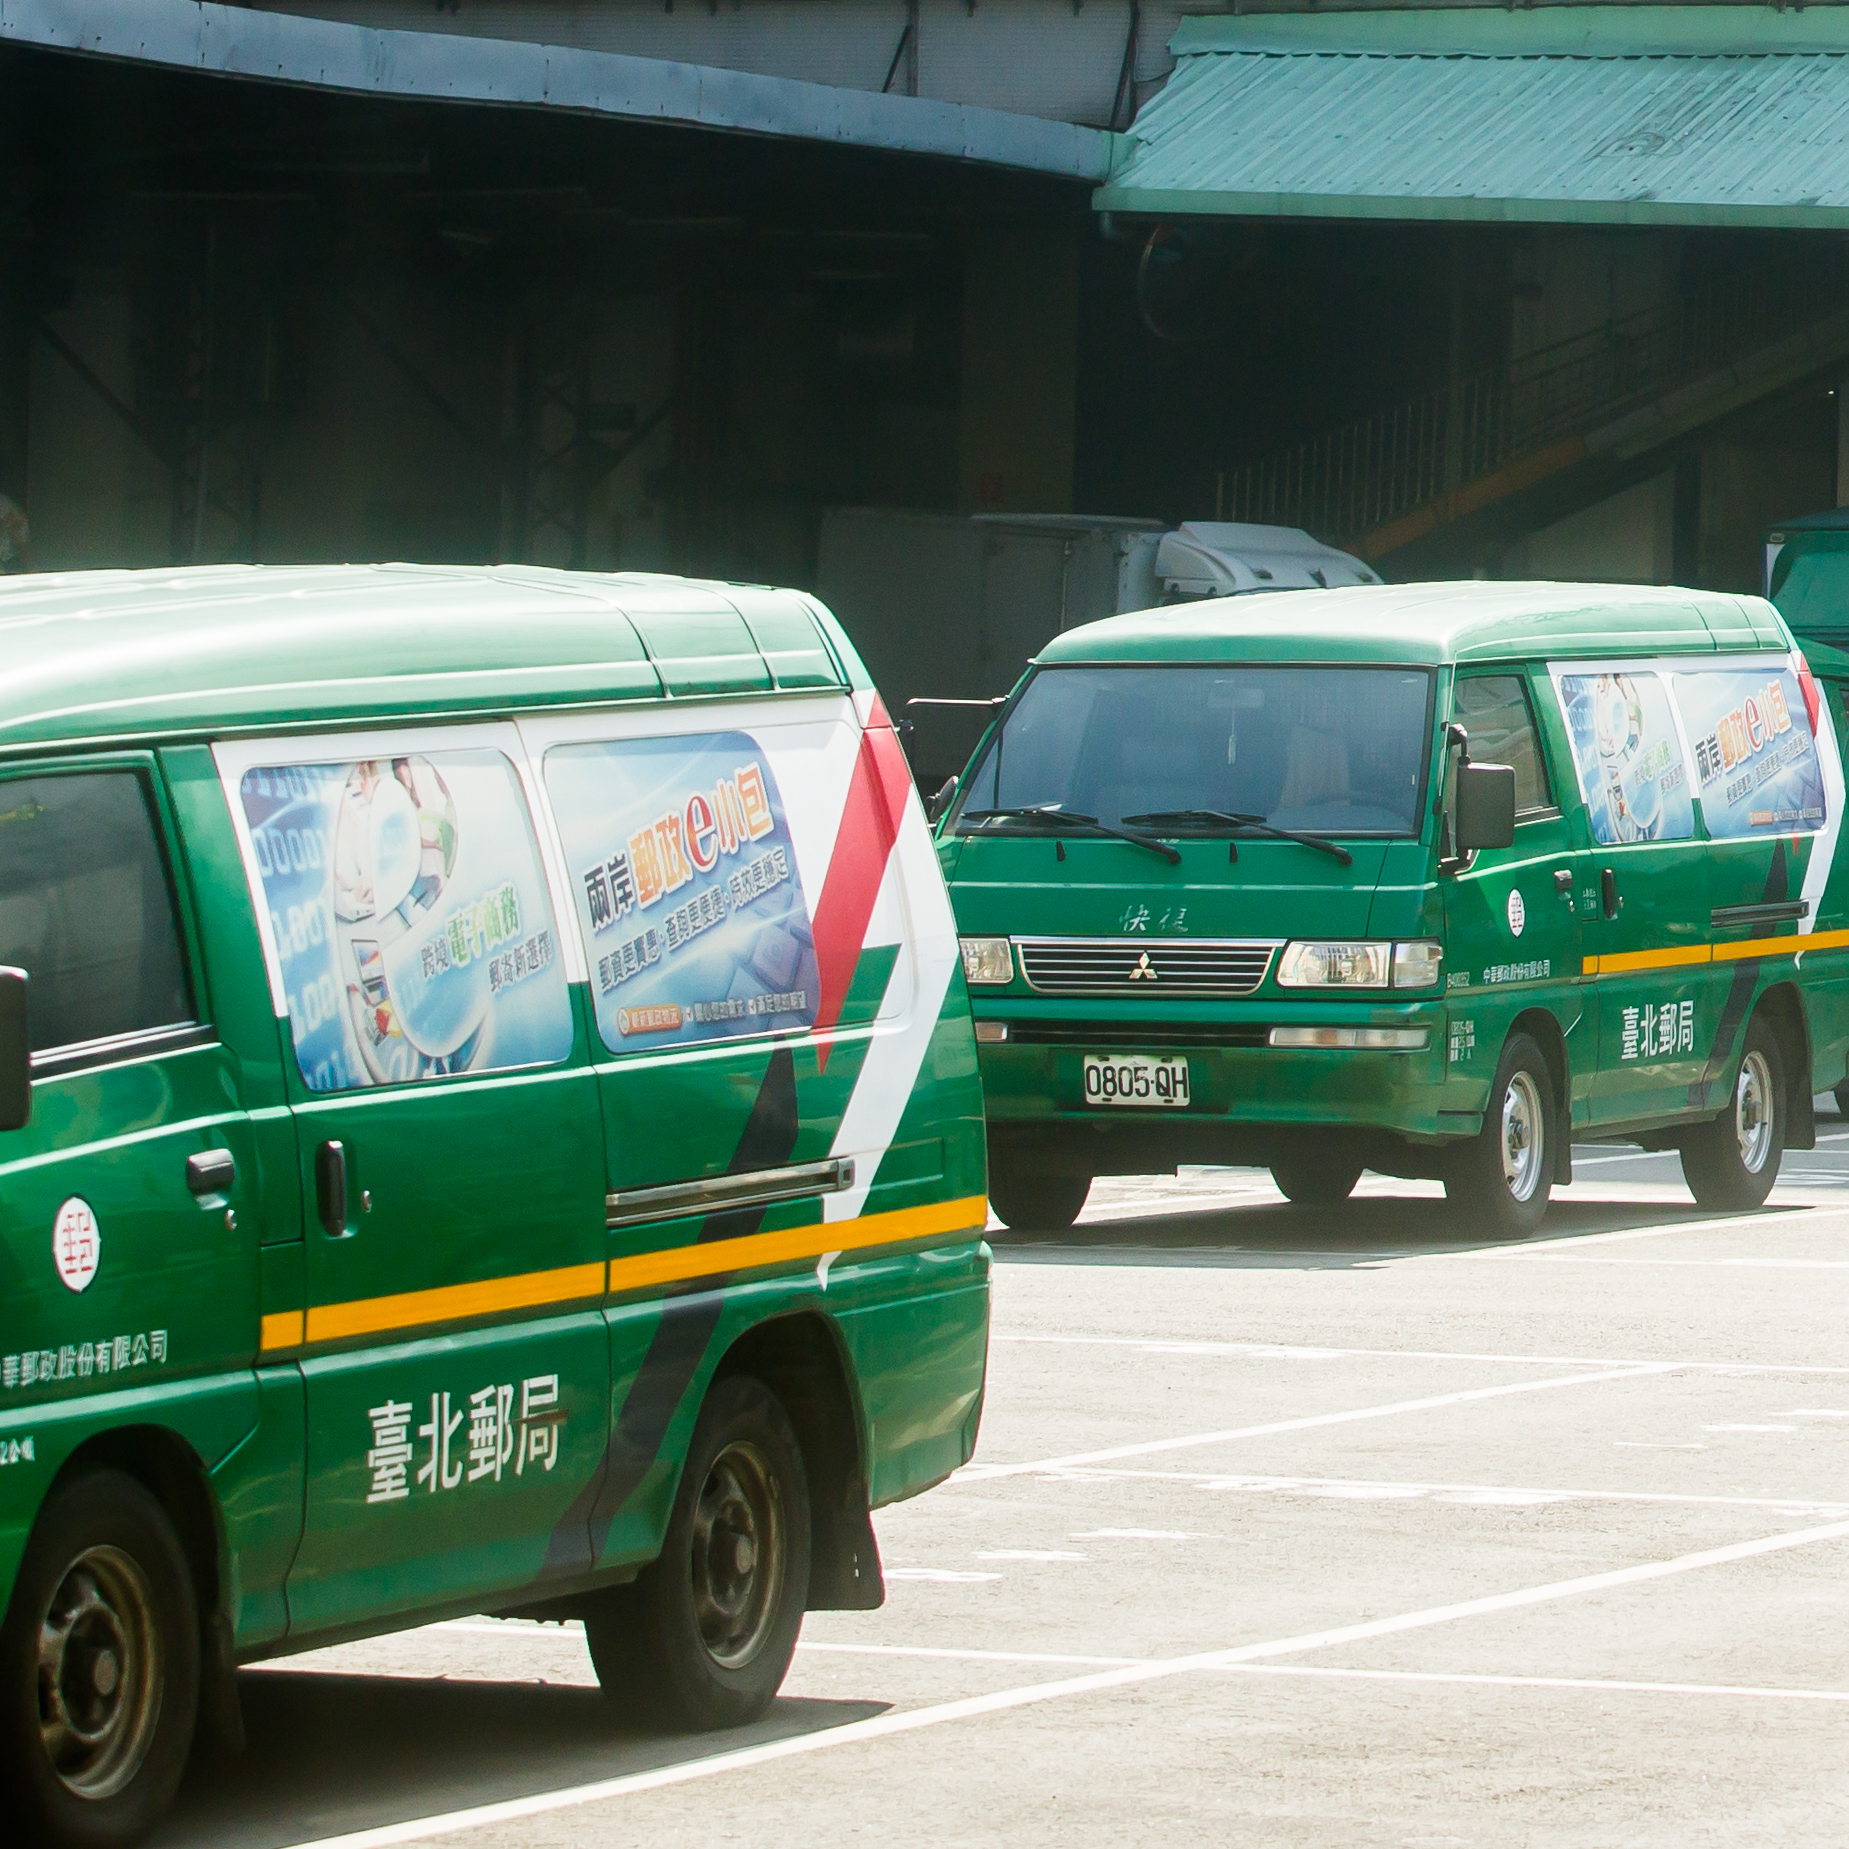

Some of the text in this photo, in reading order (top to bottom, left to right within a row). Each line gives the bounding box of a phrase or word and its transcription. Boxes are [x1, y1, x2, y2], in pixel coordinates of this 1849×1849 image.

[583, 765, 773, 929] 兩岸郵政e小包
[1483, 959, 1550, 985] 中華郵政股份有限公司
[1620, 999, 1694, 1060] 臺北郵局
[0, 1329, 168, 1388] 華郵政股份有限公司
[366, 1373, 559, 1505] 臺北郵局
